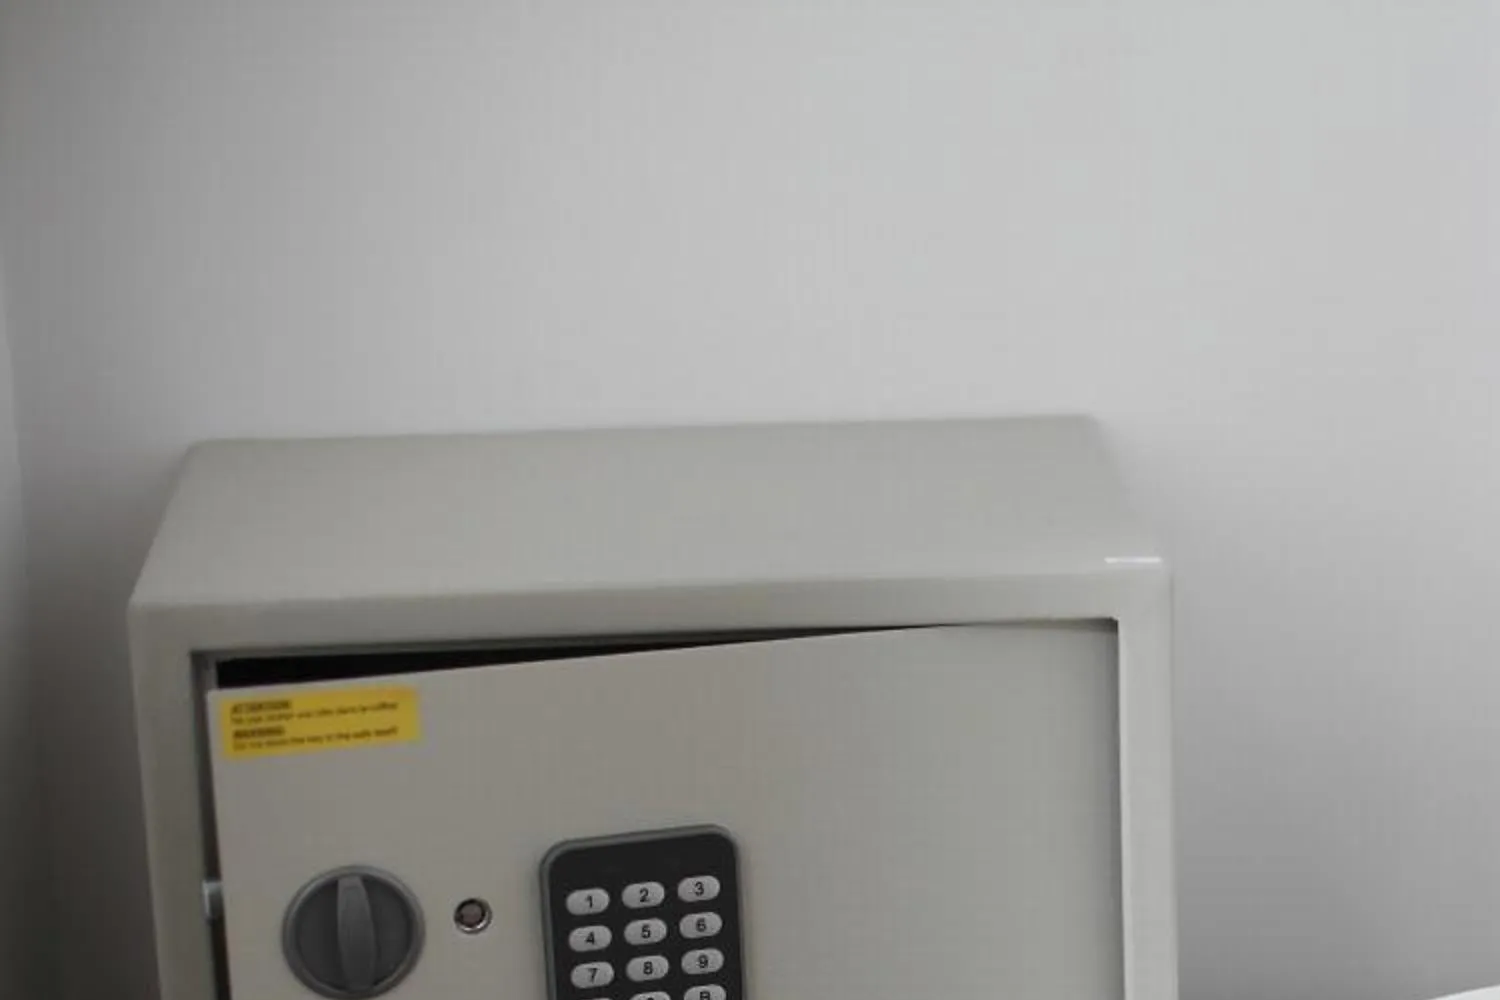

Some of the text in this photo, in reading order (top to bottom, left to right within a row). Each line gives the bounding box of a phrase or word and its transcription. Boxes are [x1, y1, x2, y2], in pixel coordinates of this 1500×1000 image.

[586, 881, 704, 908] 1 2 3
[586, 918, 706, 945] 4 5 6
[588, 955, 708, 982] 7 8 9
